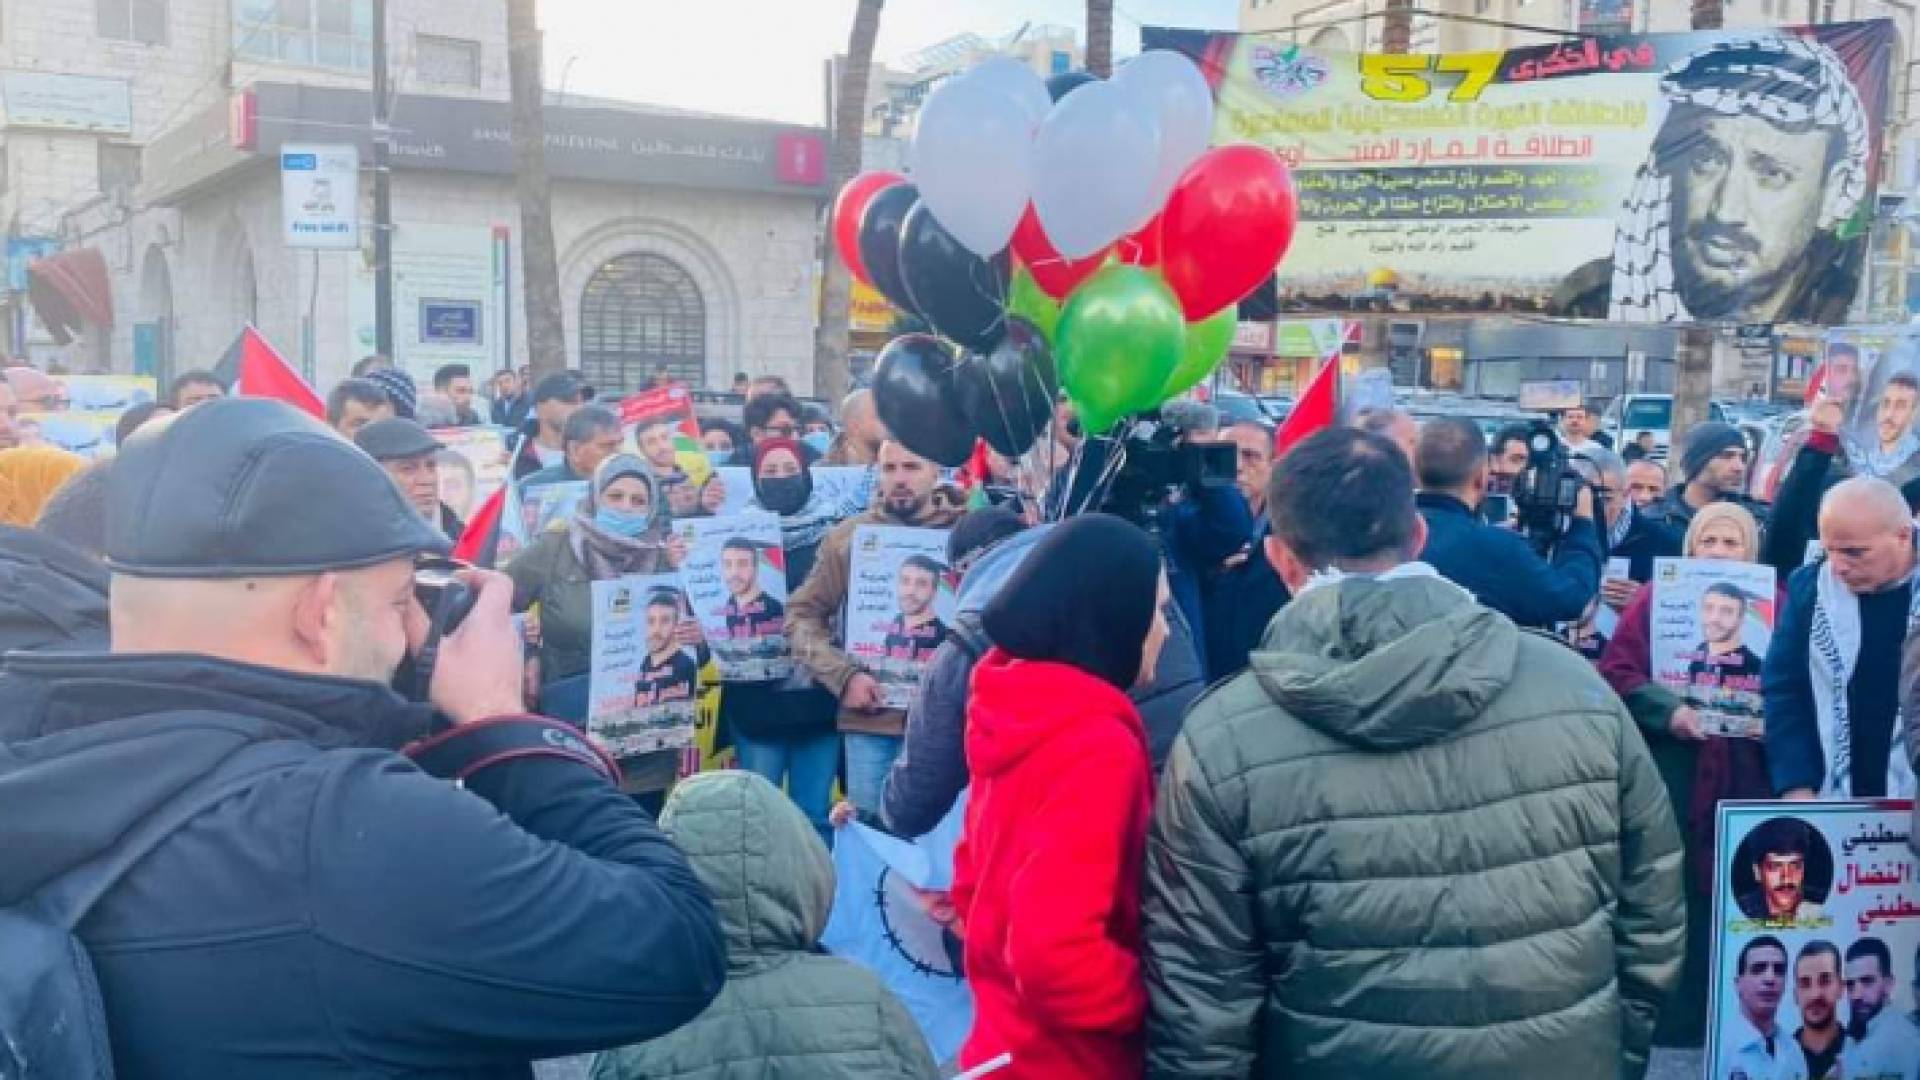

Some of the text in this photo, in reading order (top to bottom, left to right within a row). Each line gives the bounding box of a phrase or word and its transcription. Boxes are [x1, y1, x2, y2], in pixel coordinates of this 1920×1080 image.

[1603, 41, 1655, 71] في
[1358, 53, 1505, 102] 57
[1841, 822, 1911, 858] سطيني
